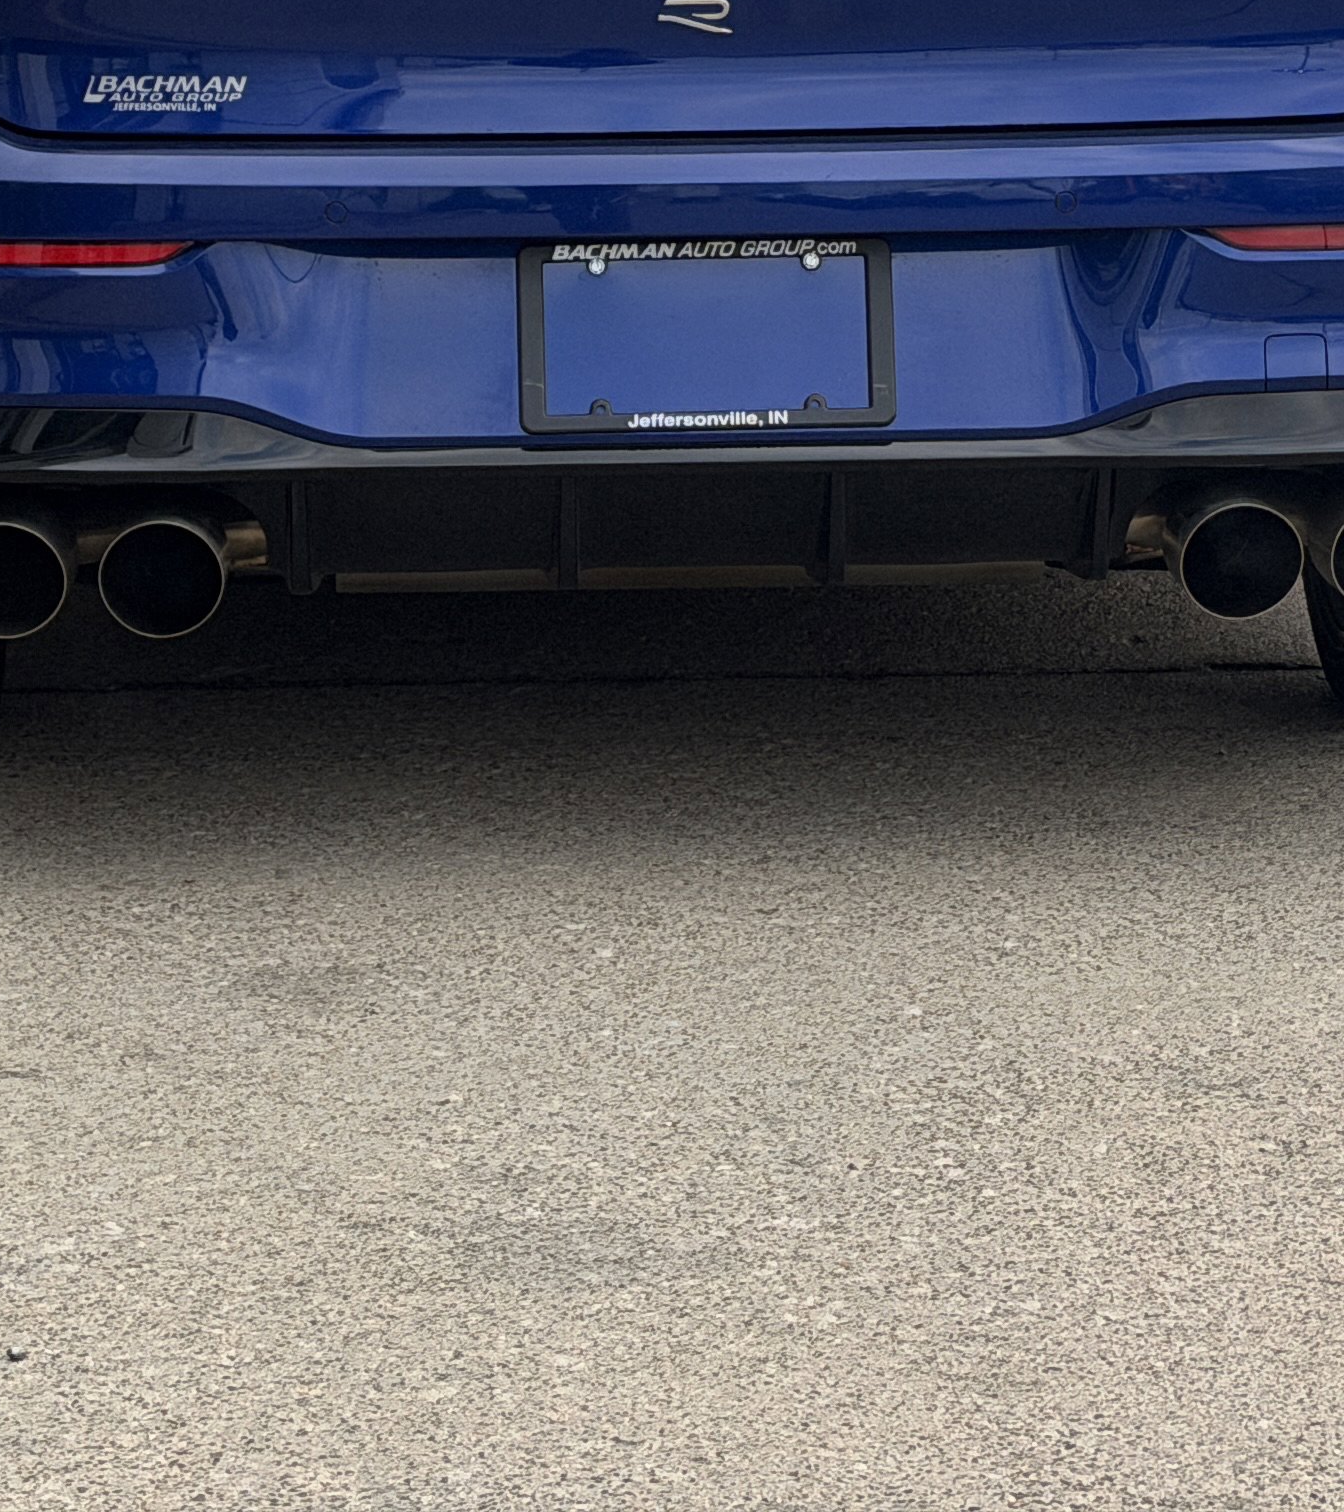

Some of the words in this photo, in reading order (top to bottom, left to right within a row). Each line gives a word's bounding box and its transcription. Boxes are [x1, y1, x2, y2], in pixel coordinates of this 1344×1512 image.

[97, 75, 248, 93] BACHMAN
[109, 92, 164, 103] AUTO
[171, 92, 243, 103] GROUP
[112, 102, 201, 113] JEFFERSONVILLE,
[204, 102, 217, 112] IN
[552, 242, 676, 261] BACHMAN
[677, 241, 736, 258] AUTO
[627, 412, 764, 430] Jeffersonville,
[768, 410, 789, 426] IN
